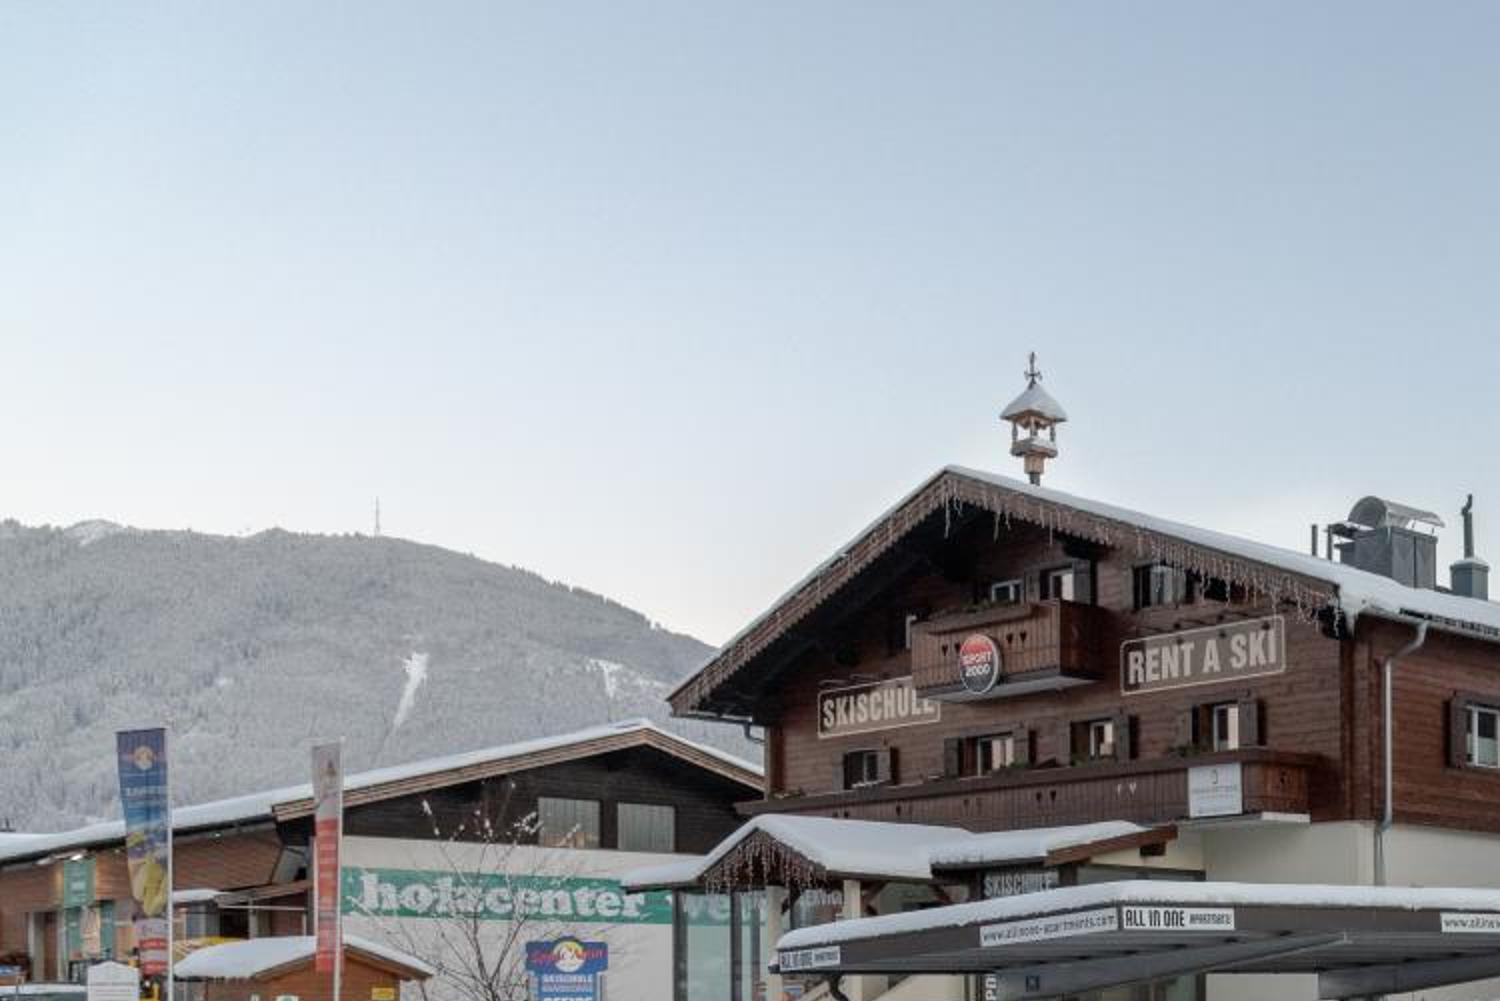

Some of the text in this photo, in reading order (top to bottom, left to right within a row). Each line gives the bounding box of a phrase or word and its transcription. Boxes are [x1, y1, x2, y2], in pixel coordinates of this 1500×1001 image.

[961, 651, 993, 666] SPORT
[1128, 630, 1277, 685] RENT A SKI
[965, 663, 991, 677] 2000
[360, 872, 645, 917] holzcenter
[1125, 909, 1146, 927] ALL
[1149, 909, 1161, 927] IN
[1164, 909, 1185, 927] ONE
